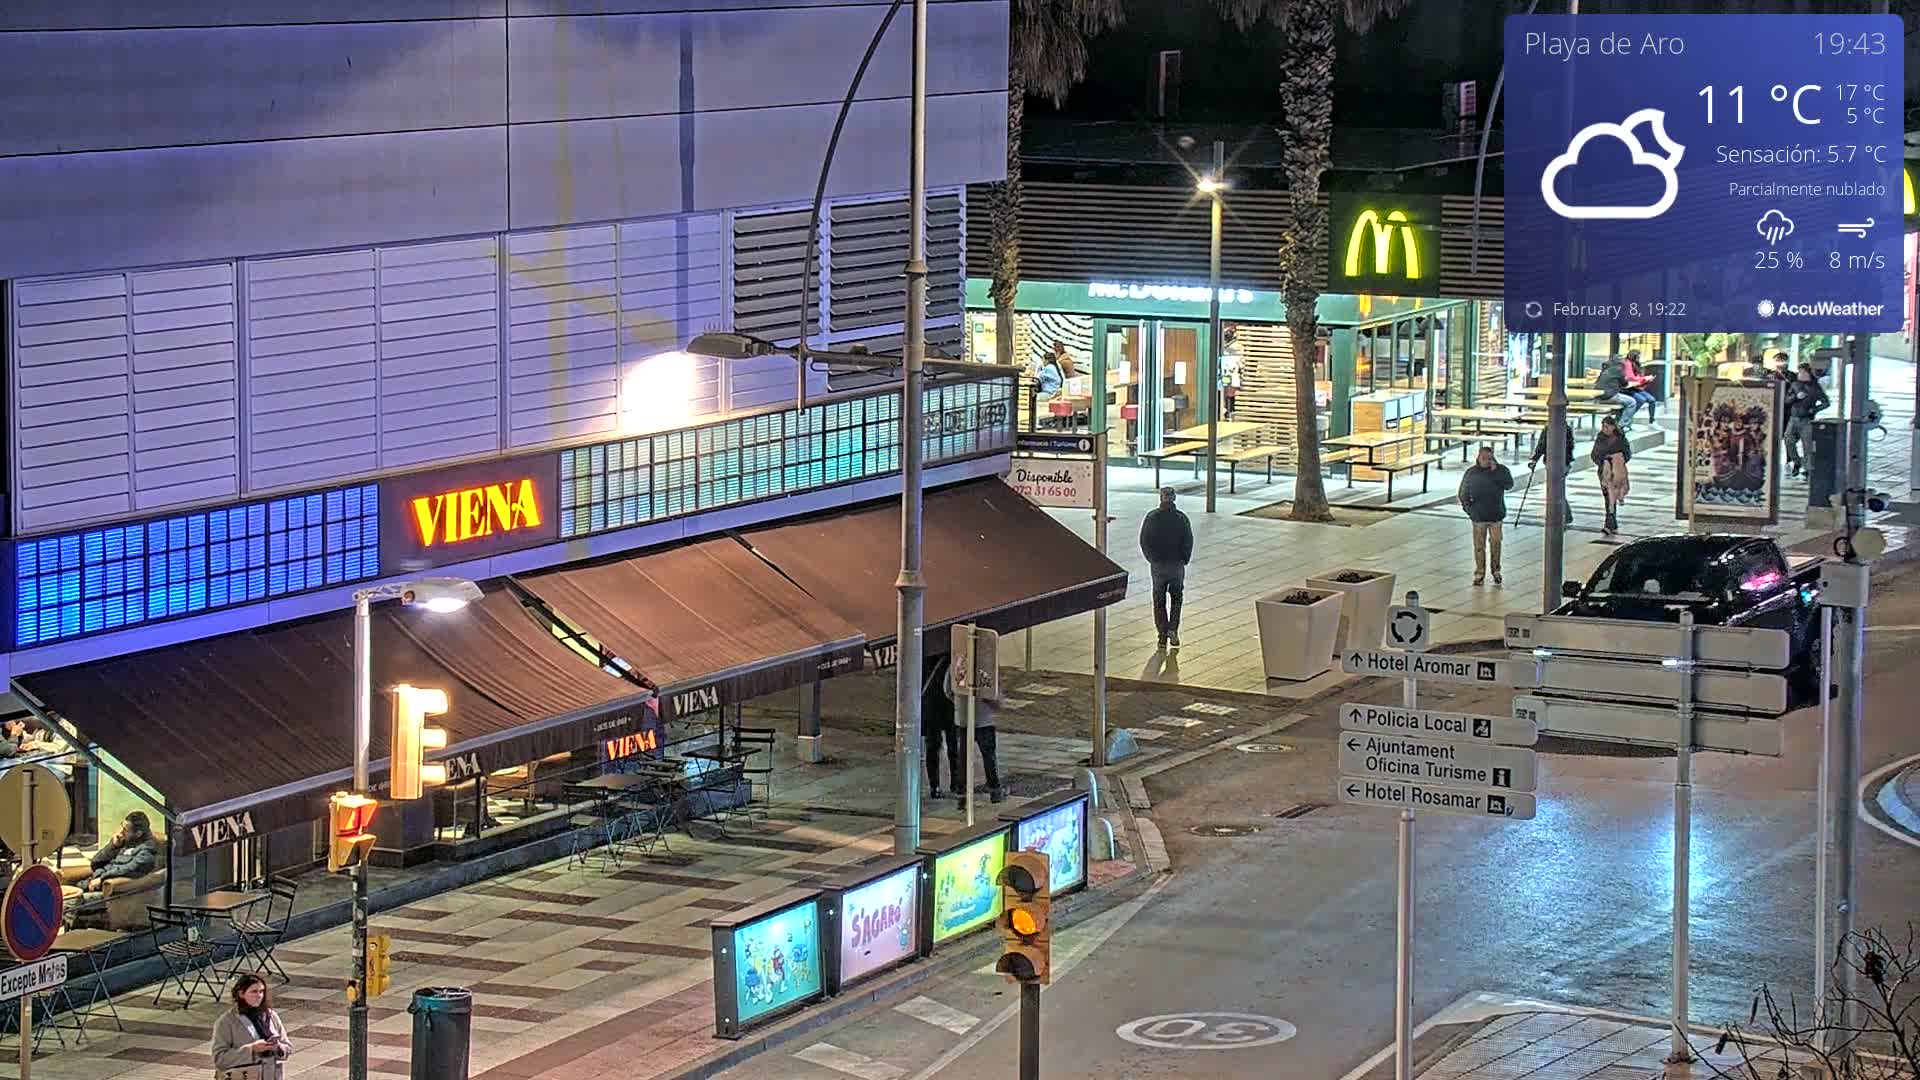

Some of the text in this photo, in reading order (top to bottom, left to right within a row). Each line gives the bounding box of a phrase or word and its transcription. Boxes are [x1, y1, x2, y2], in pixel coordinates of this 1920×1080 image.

[1016, 469, 1074, 484] Disponible
[413, 480, 541, 546] VIENA
[1368, 654, 1471, 676] Hotel Aromar
[673, 686, 719, 716] VIENA
[1366, 708, 1467, 733] Policia Local
[606, 729, 657, 761] VIENA
[1366, 737, 1456, 760] Ajuntament
[446, 752, 481, 782] ENA
[1366, 756, 1487, 782] Oficina Turisme
[1365, 782, 1482, 809] Hotel Rosamar
[191, 811, 254, 849] VIENA
[1, 971, 37, 994] Excepte
